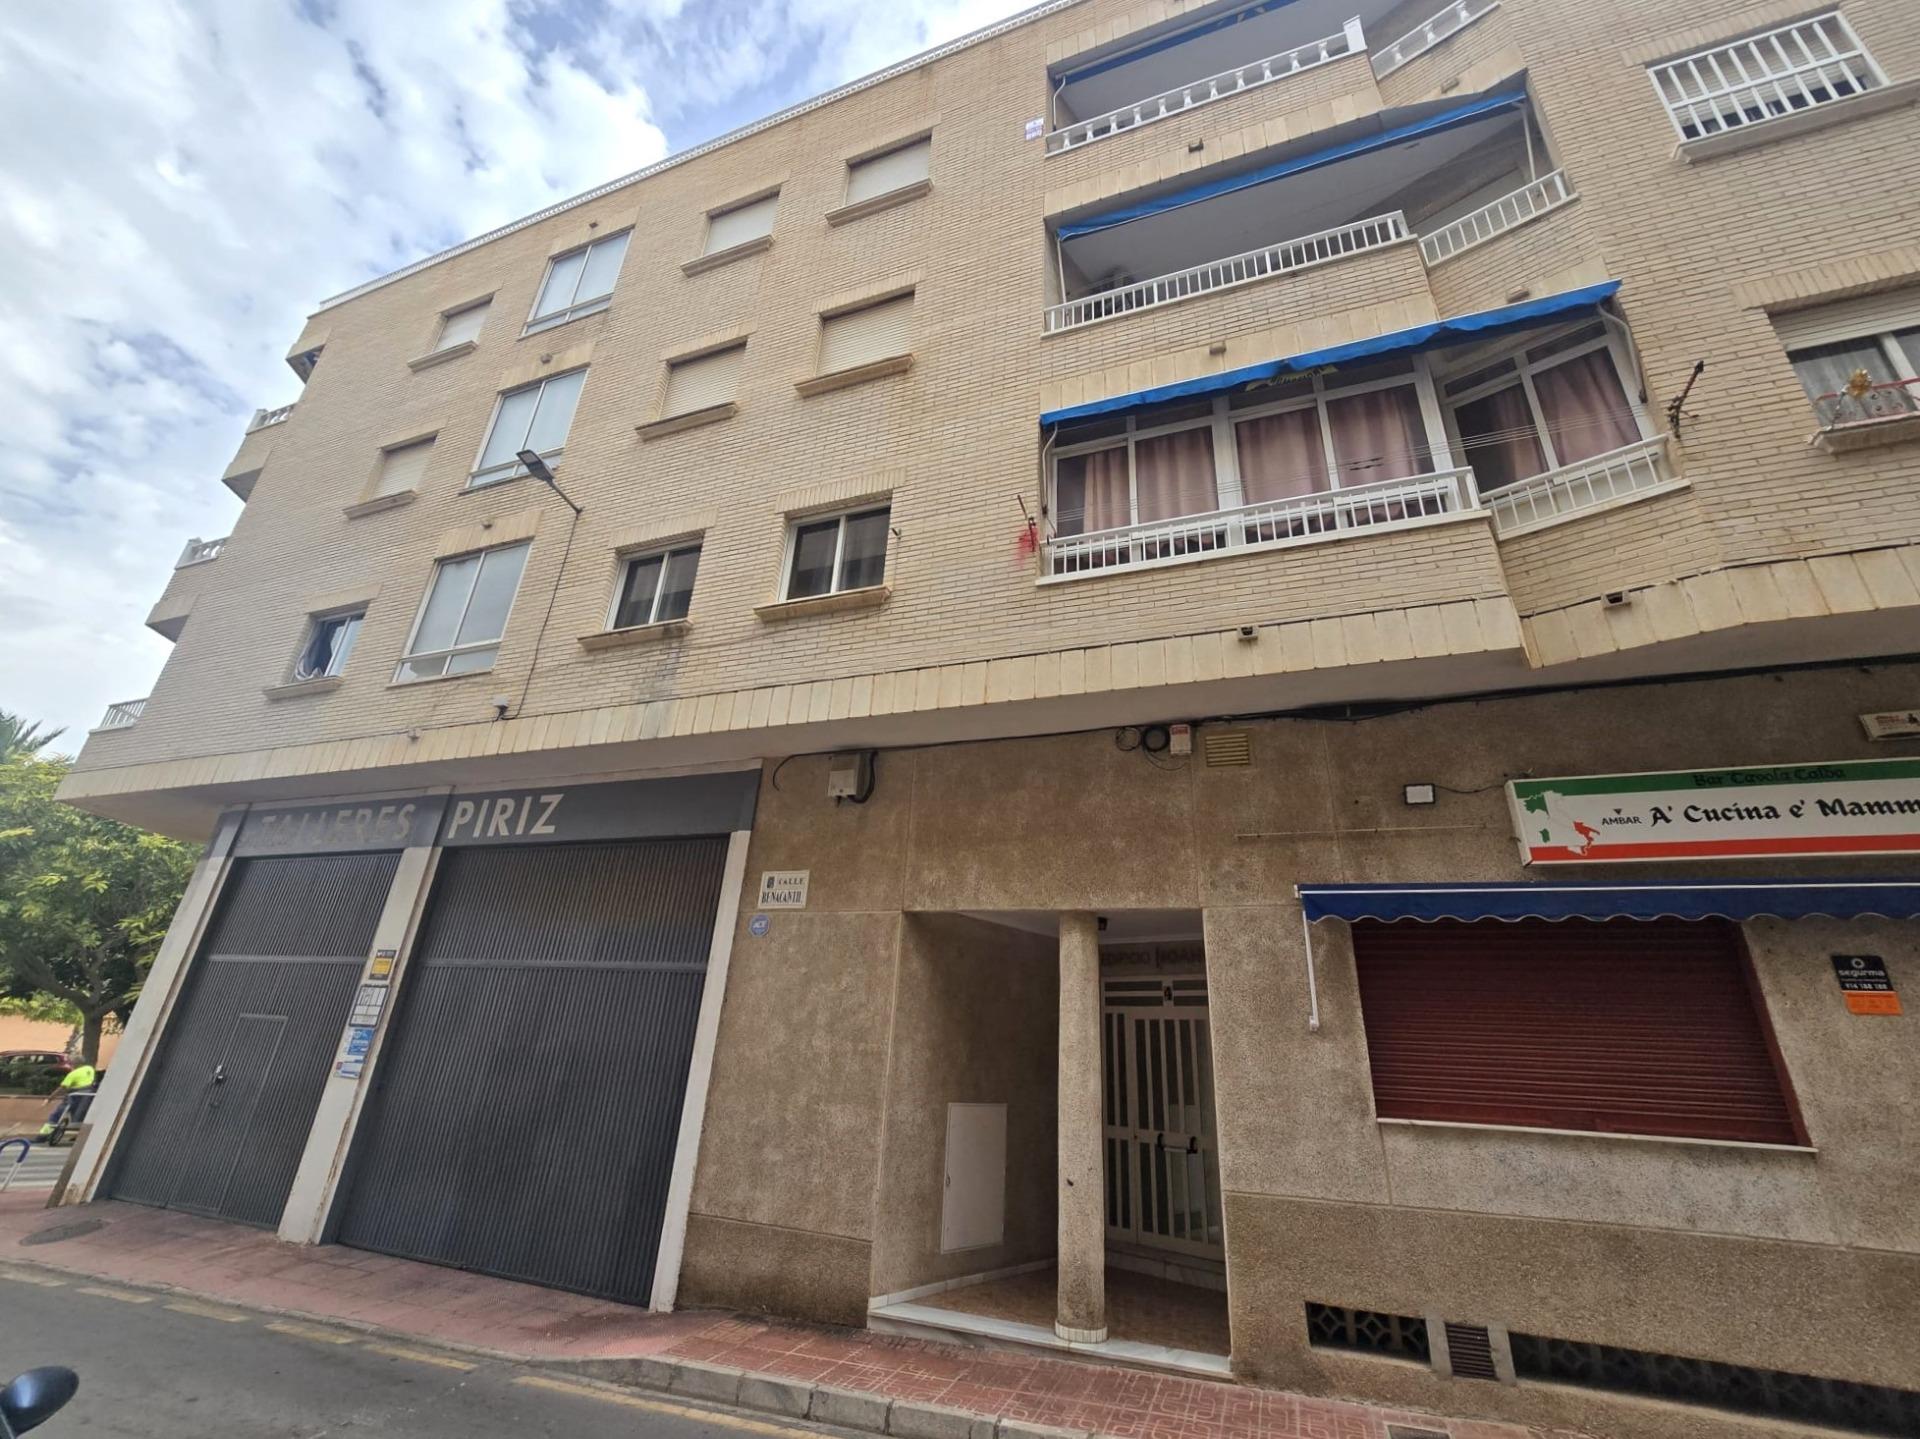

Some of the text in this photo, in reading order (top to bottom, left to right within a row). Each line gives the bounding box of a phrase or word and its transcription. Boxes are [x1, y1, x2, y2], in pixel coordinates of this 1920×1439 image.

[1692, 774, 1723, 786] Bar
[448, 794, 565, 839] PIRIZ
[1601, 816, 1642, 825] AMBAR
[1683, 802, 1782, 823] Cucina
